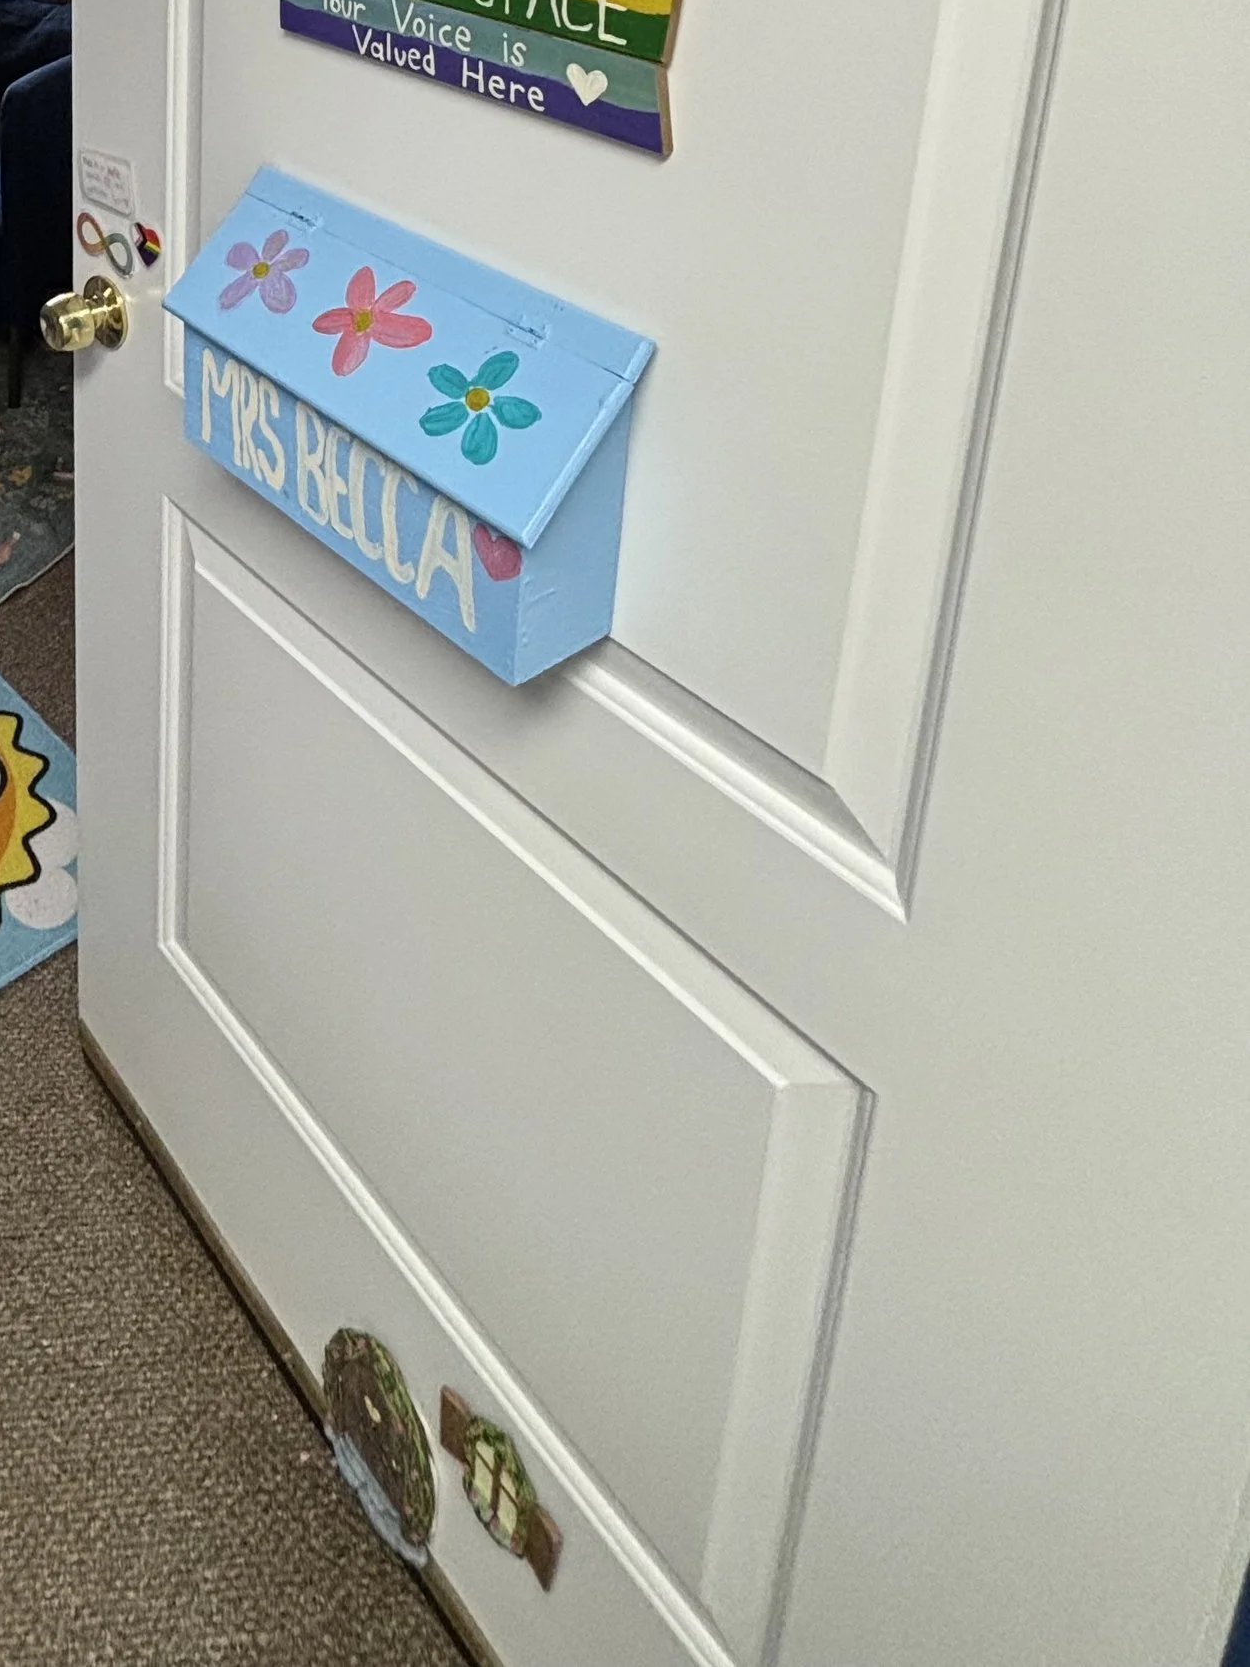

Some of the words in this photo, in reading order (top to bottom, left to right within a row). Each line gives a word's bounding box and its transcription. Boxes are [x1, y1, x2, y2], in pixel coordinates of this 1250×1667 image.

[352, 24, 436, 76] Valued
[461, 57, 546, 112] Here
[502, 33, 527, 66] is
[202, 348, 285, 491] MRS
[296, 400, 477, 633] BECCA
